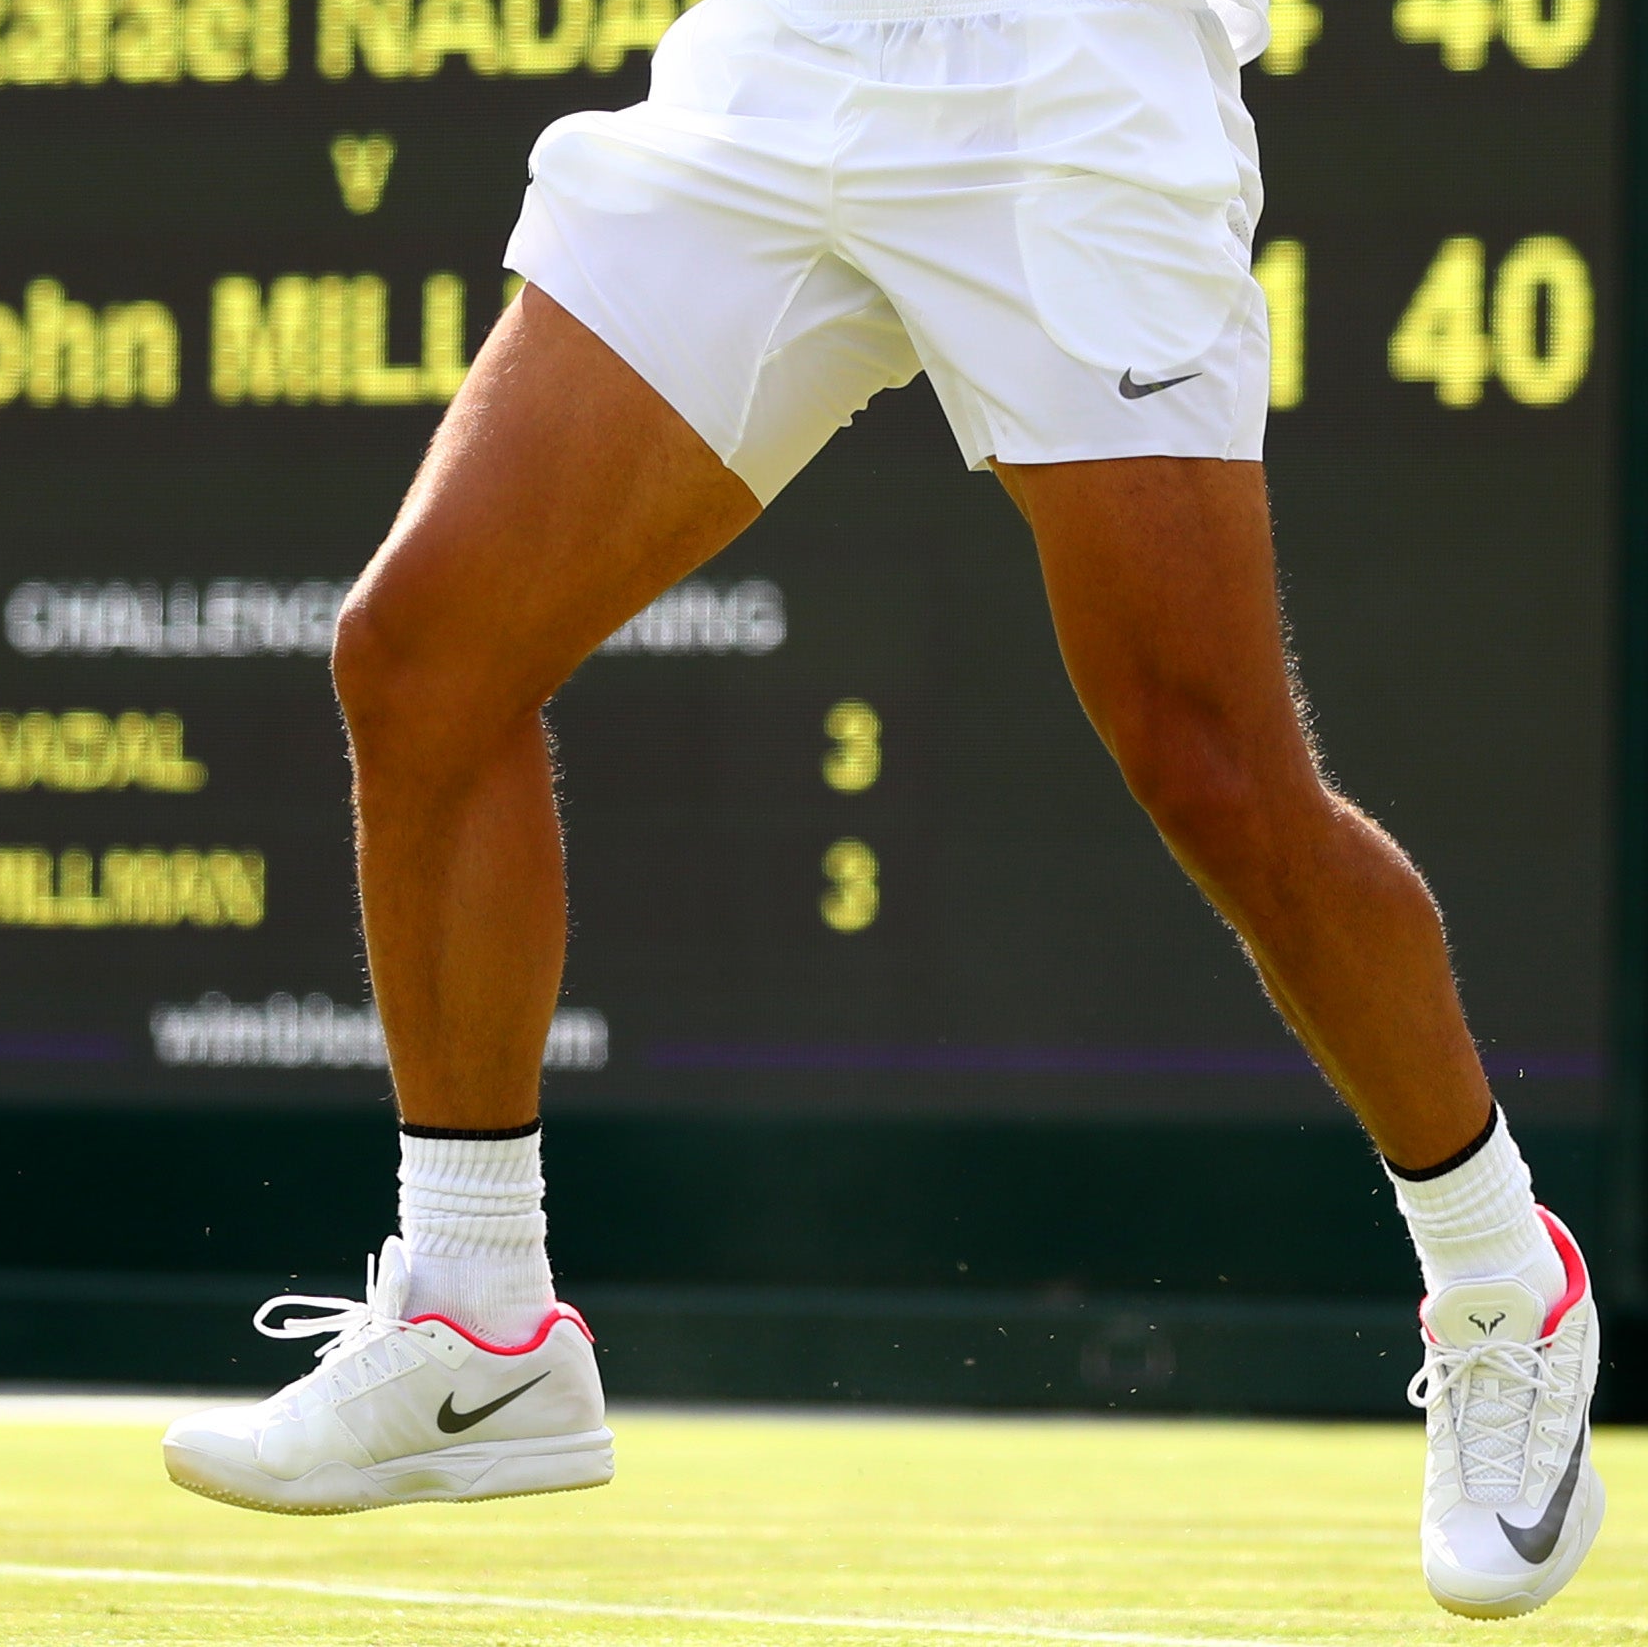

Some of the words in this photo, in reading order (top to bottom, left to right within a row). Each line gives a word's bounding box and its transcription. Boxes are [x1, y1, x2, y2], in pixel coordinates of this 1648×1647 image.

[210, 270, 527, 406] MILL
[1386, 232, 1596, 409] 40
[3, 579, 359, 657] CHALLENG
[821, 698, 881, 794] 3
[820, 837, 879, 934] 3
